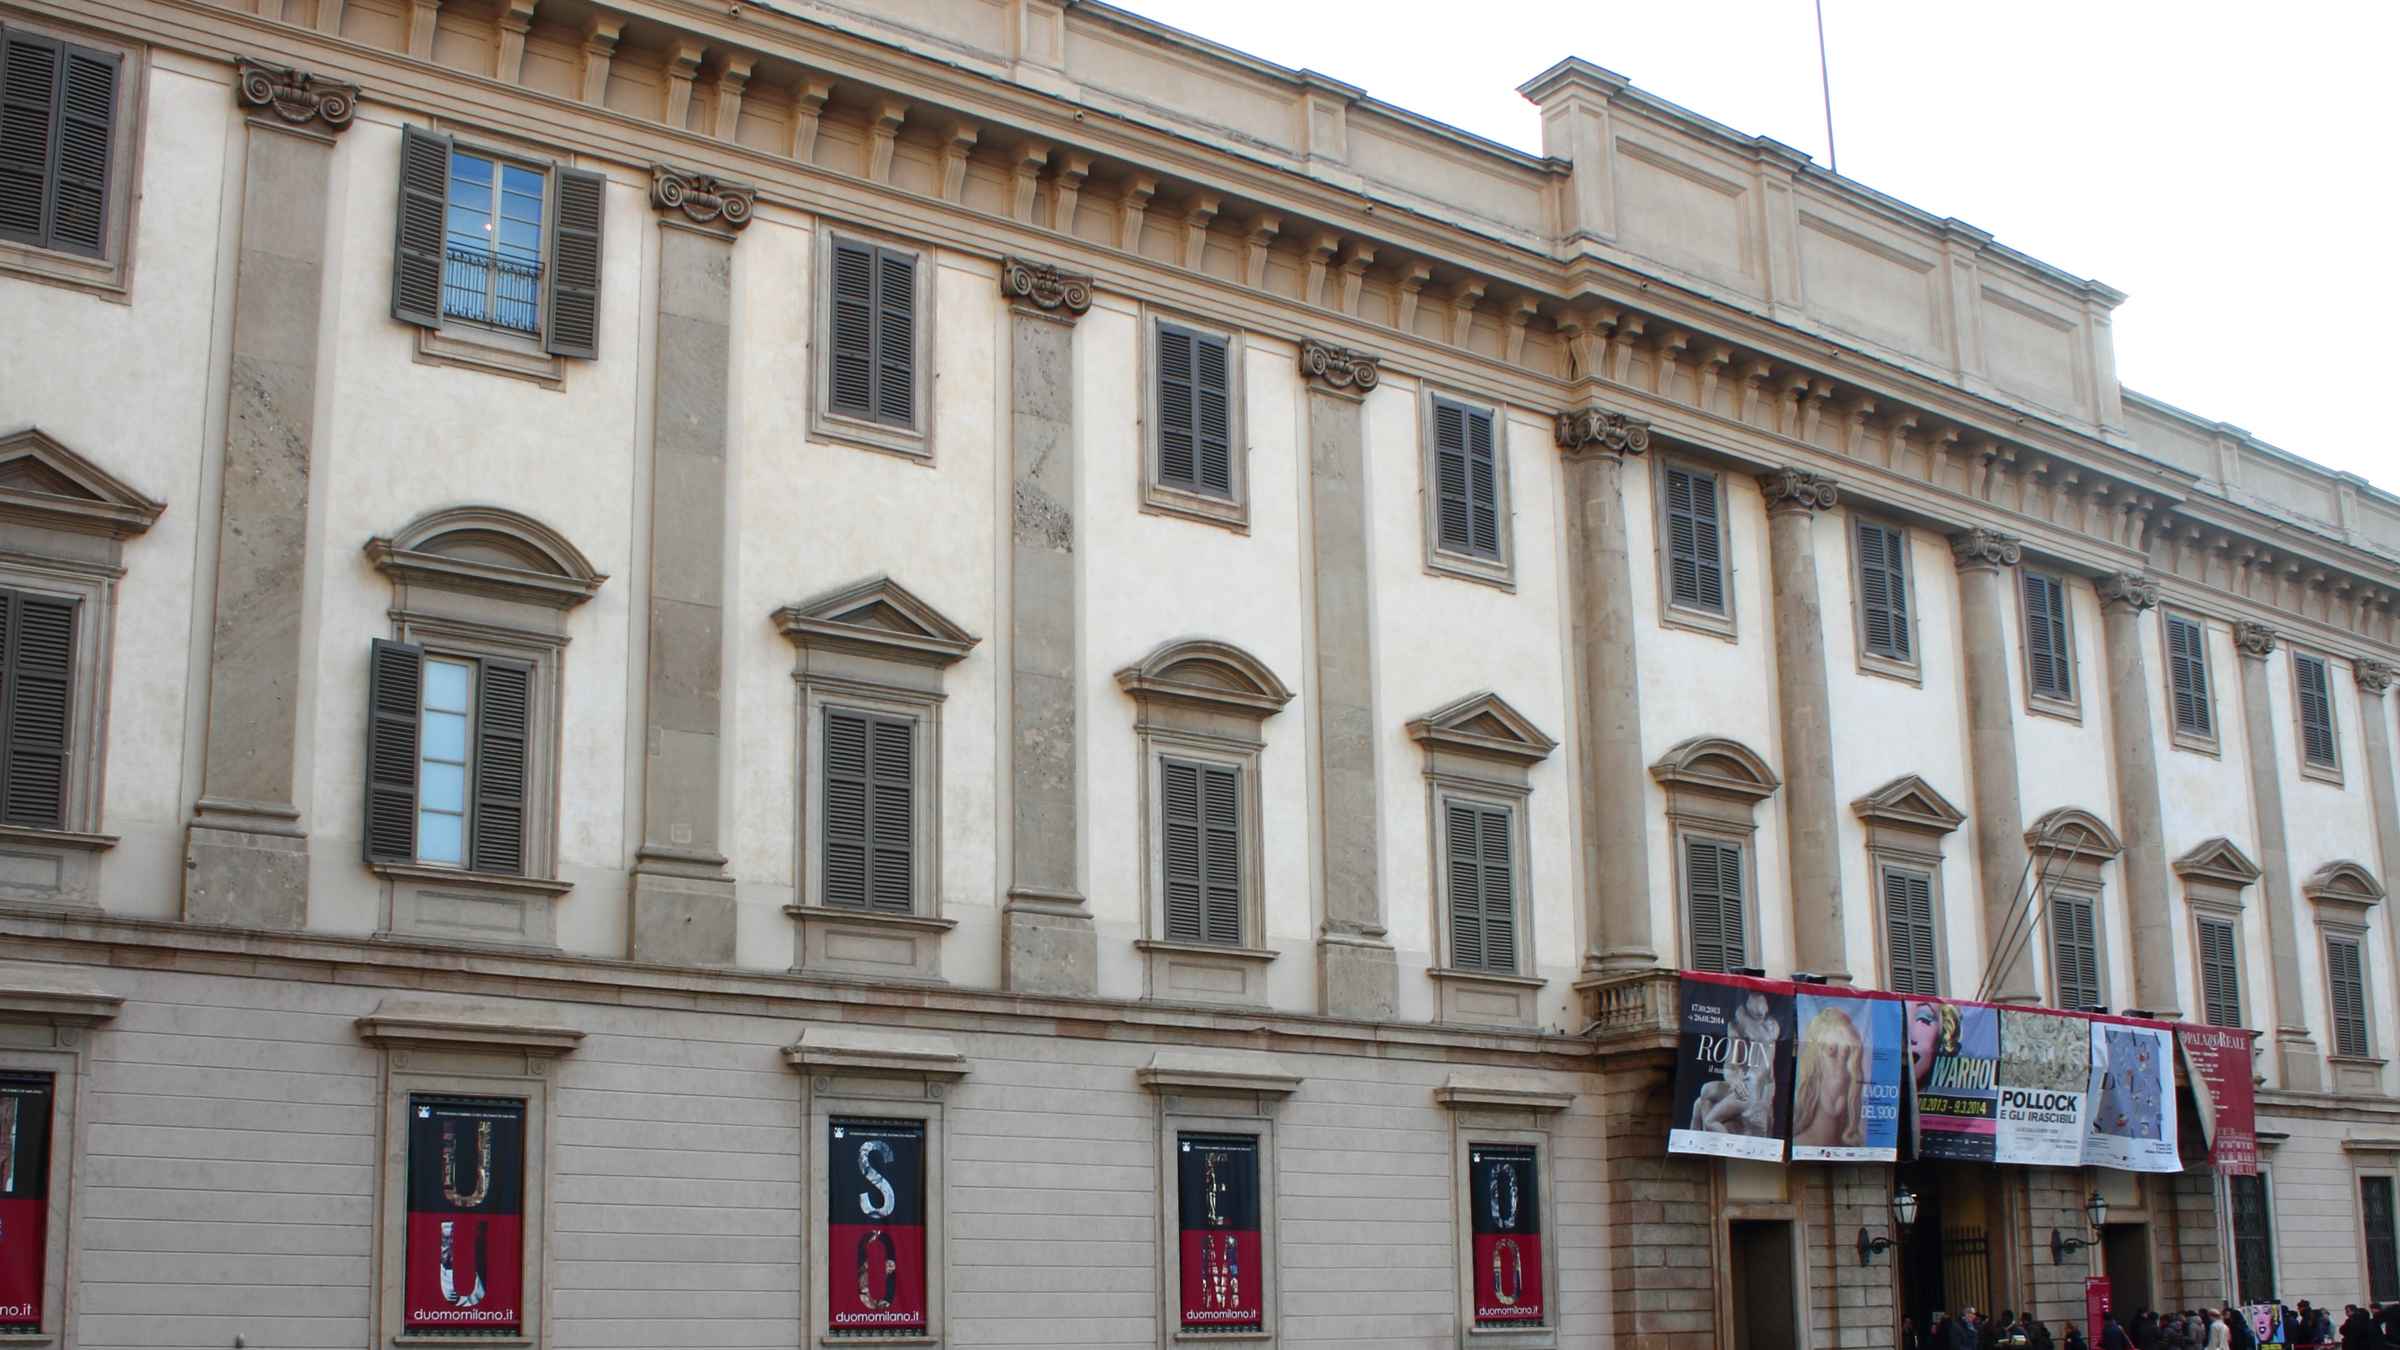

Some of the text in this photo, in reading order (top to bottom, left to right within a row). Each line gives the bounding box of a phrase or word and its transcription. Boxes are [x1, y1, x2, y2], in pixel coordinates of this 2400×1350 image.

[1696, 1034, 1773, 1069] RODIN
[1931, 1055, 1998, 1091] WARHOL
[2000, 1109, 2077, 1124] E GLI IRASCIBILI
[2001, 1090, 2078, 1112] POLLOCK
[441, 1119, 492, 1207] U
[858, 1139, 896, 1219] S
[440, 1221, 488, 1307] U
[858, 1229, 896, 1310] O
[1493, 1237, 1523, 1306] O
[414, 1308, 514, 1322] duomomilano.it
[835, 1311, 920, 1323] duomomilano.it
[1186, 1308, 1257, 1320] duomomilano.it
[1479, 1305, 1539, 1317] duomomilano.it
